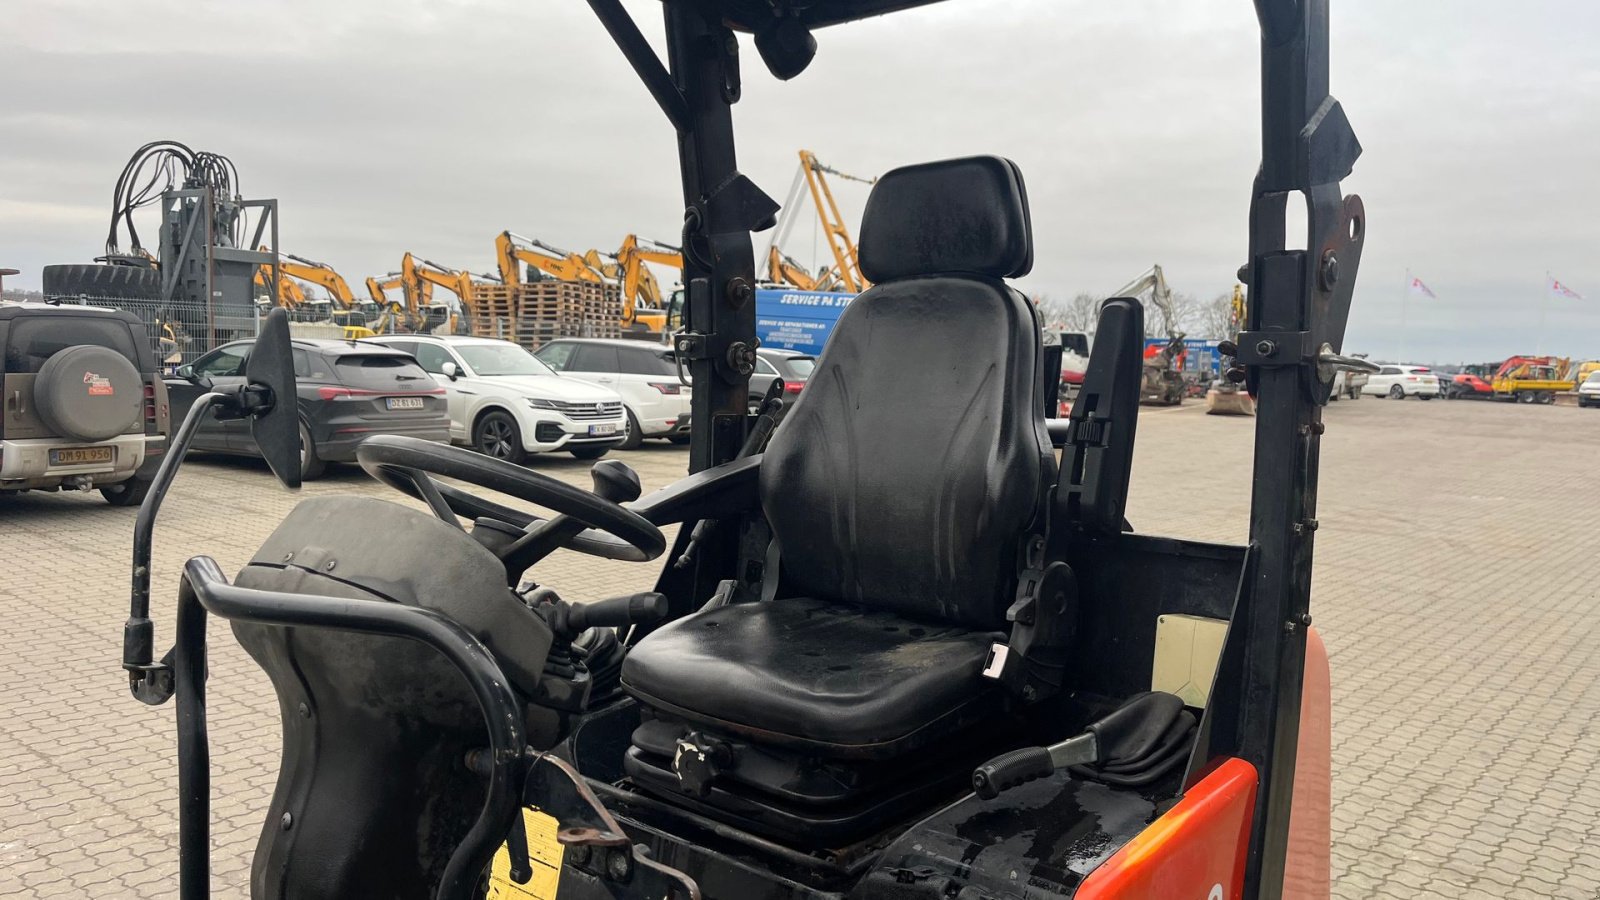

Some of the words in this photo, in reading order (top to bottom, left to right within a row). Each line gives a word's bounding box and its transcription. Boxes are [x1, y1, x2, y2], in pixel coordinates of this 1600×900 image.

[780, 294, 821, 307] SERVICE
[391, 399, 401, 407] DZ
[58, 451, 73, 461] DM
[75, 450, 87, 461] 91
[90, 448, 109, 459] 956
